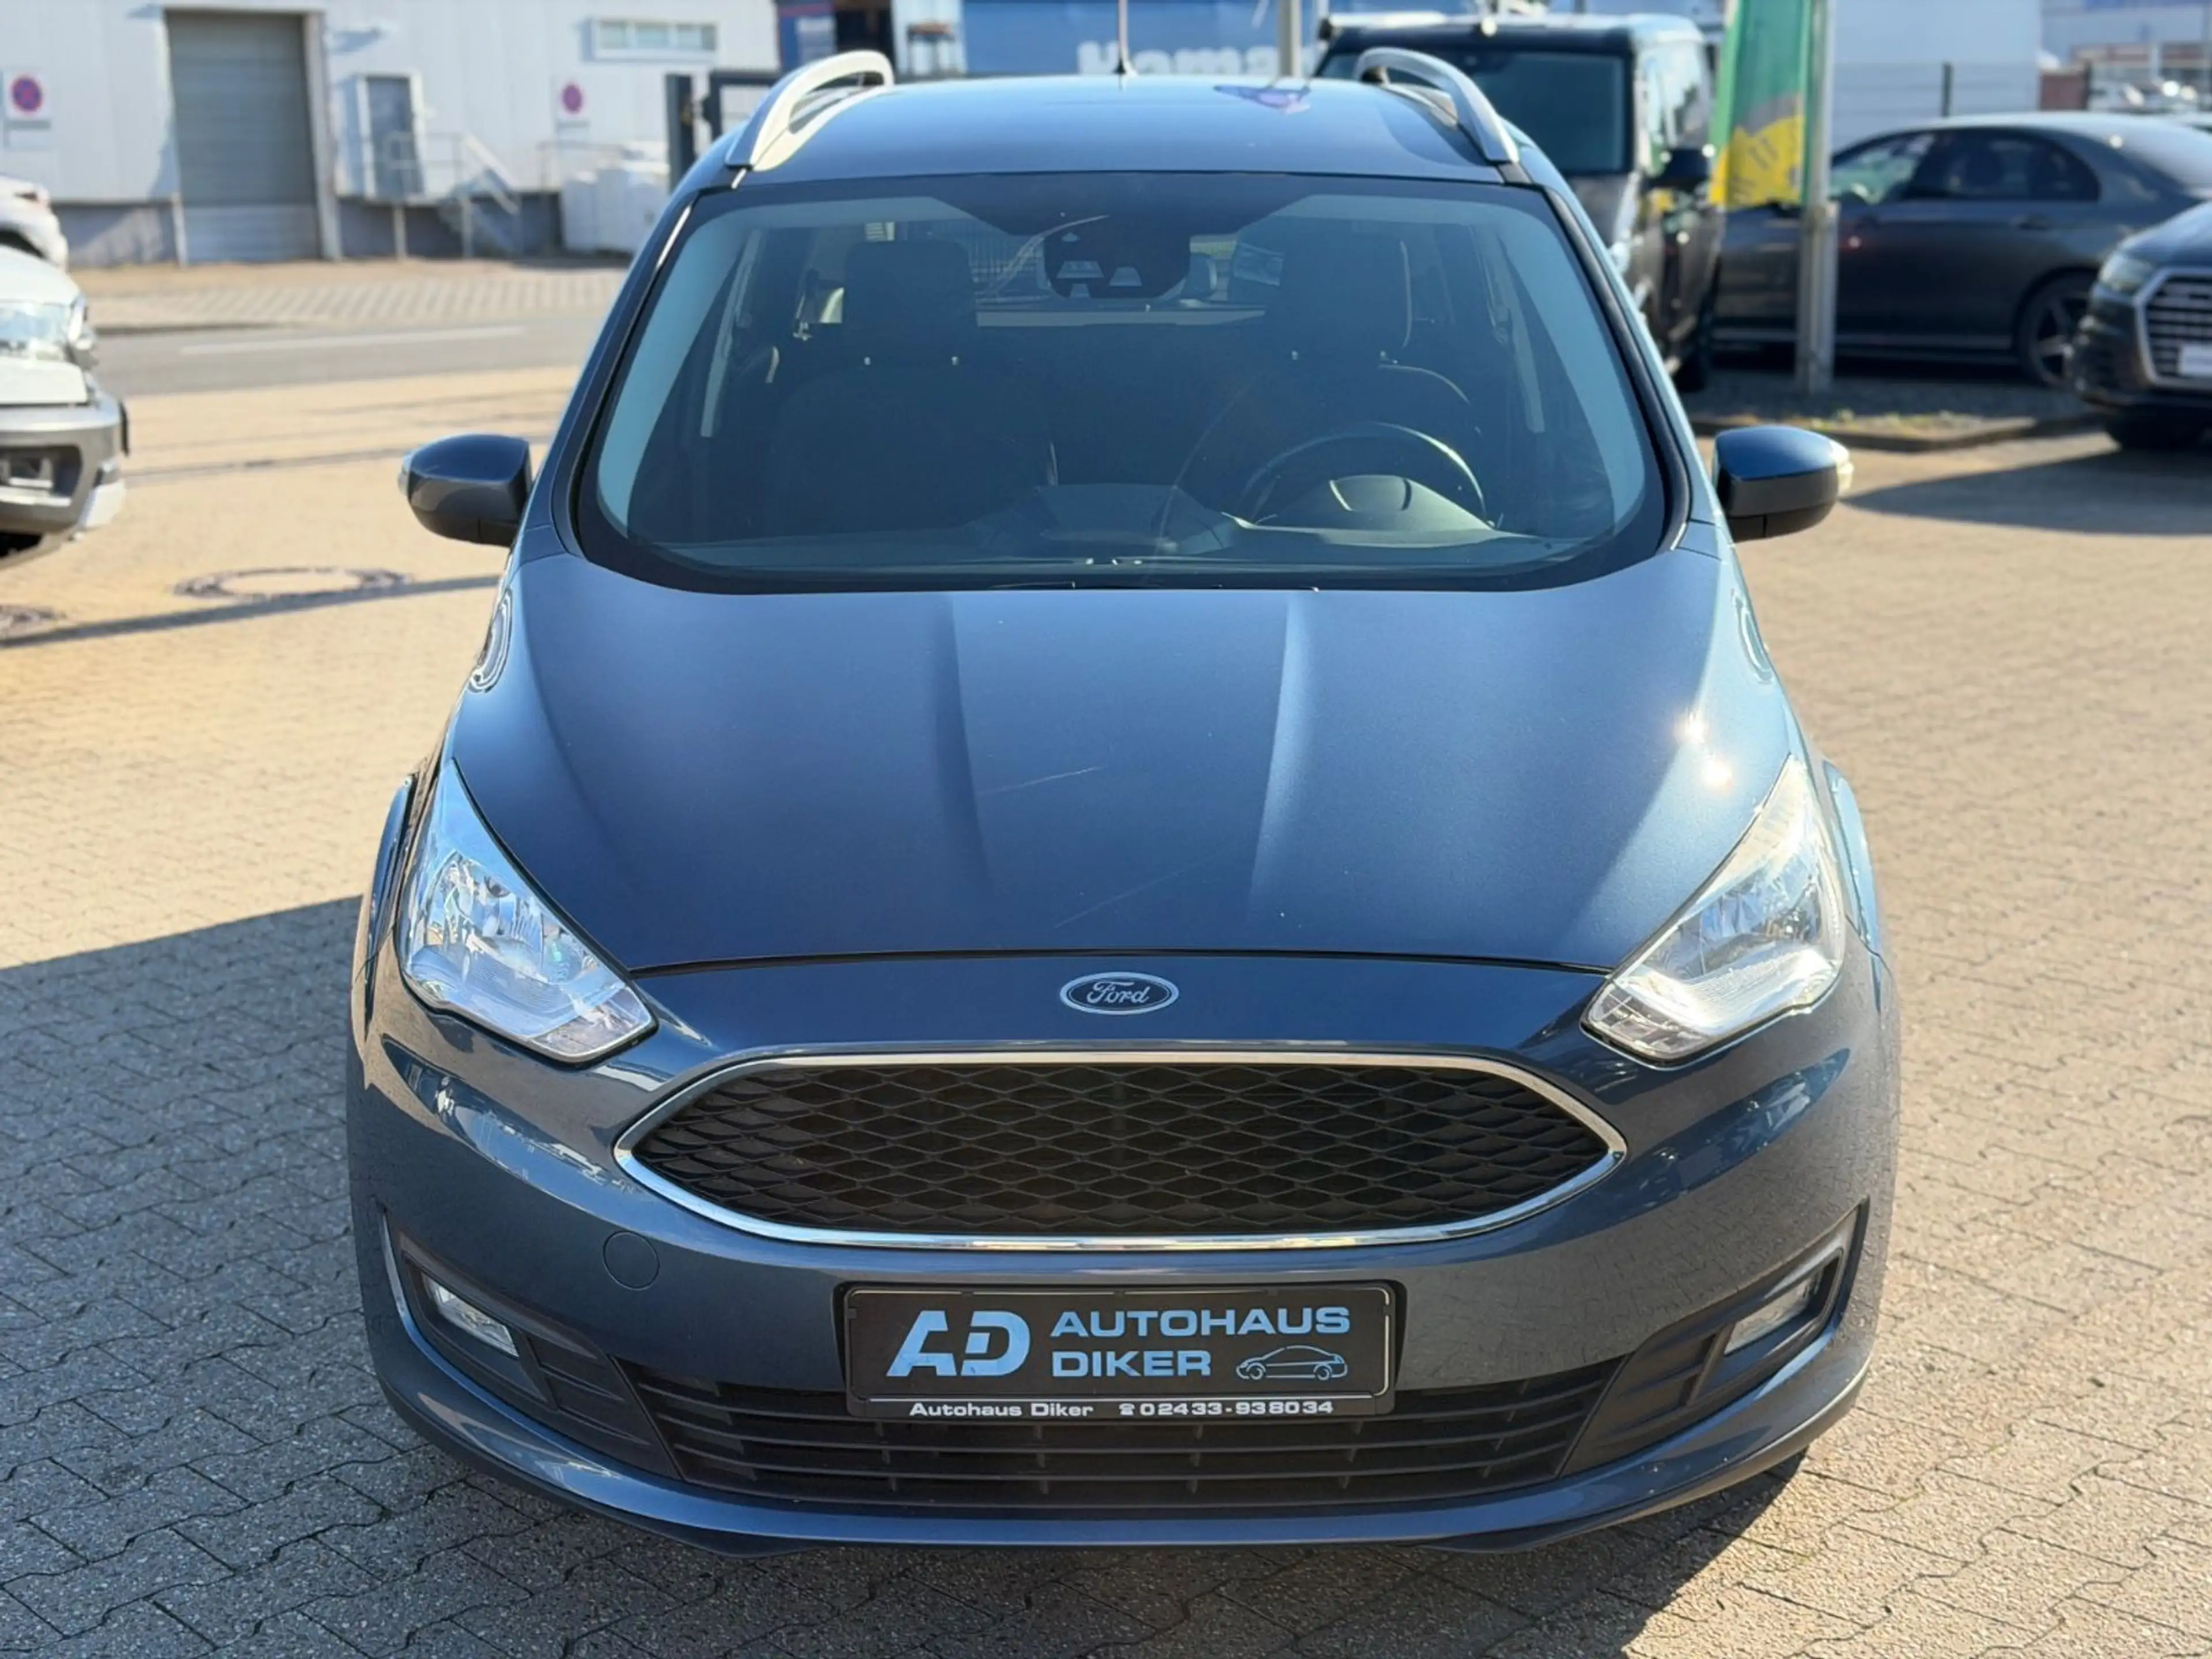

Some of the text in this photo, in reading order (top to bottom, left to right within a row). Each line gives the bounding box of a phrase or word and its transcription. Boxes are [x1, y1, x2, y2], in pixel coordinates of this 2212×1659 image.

[1086, 981, 1151, 1004] Ford
[1050, 1307, 1350, 1338] AUTOHAUS
[886, 1309, 1031, 1377] AD
[1052, 1350, 1211, 1377] DIKER
[909, 1401, 1334, 1417] Autohaus Diker 02433-938034
